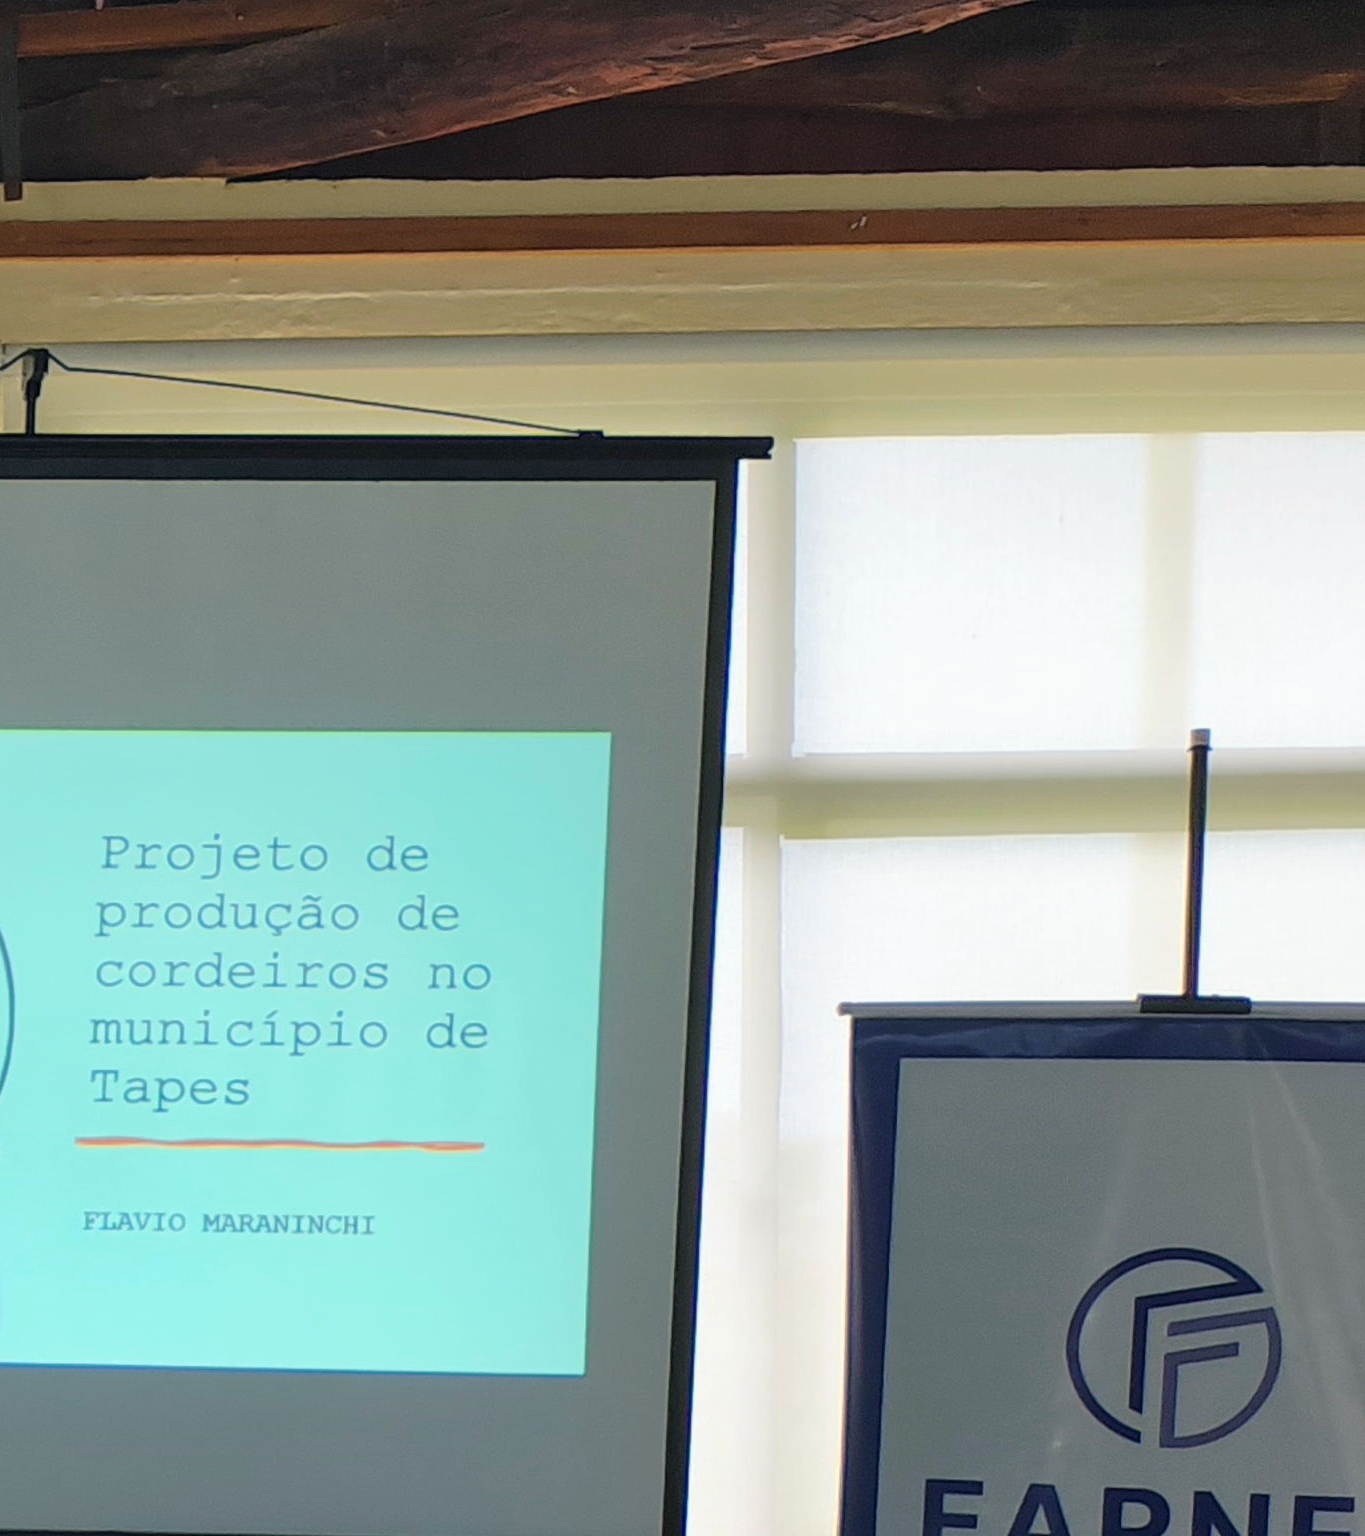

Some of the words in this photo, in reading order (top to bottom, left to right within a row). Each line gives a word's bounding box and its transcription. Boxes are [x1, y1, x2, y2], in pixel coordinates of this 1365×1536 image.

[102, 834, 327, 879] Projeto
[367, 836, 428, 871] de
[95, 893, 358, 937] produção
[398, 895, 459, 931] de
[96, 952, 387, 989] cordeiros
[429, 964, 491, 990] no
[89, 1010, 387, 1056] município
[427, 1013, 487, 1048] de
[91, 1070, 248, 1112] Tapes
[83, 1212, 185, 1231] FLAVIO
[202, 1214, 374, 1234] MARANINCHI
